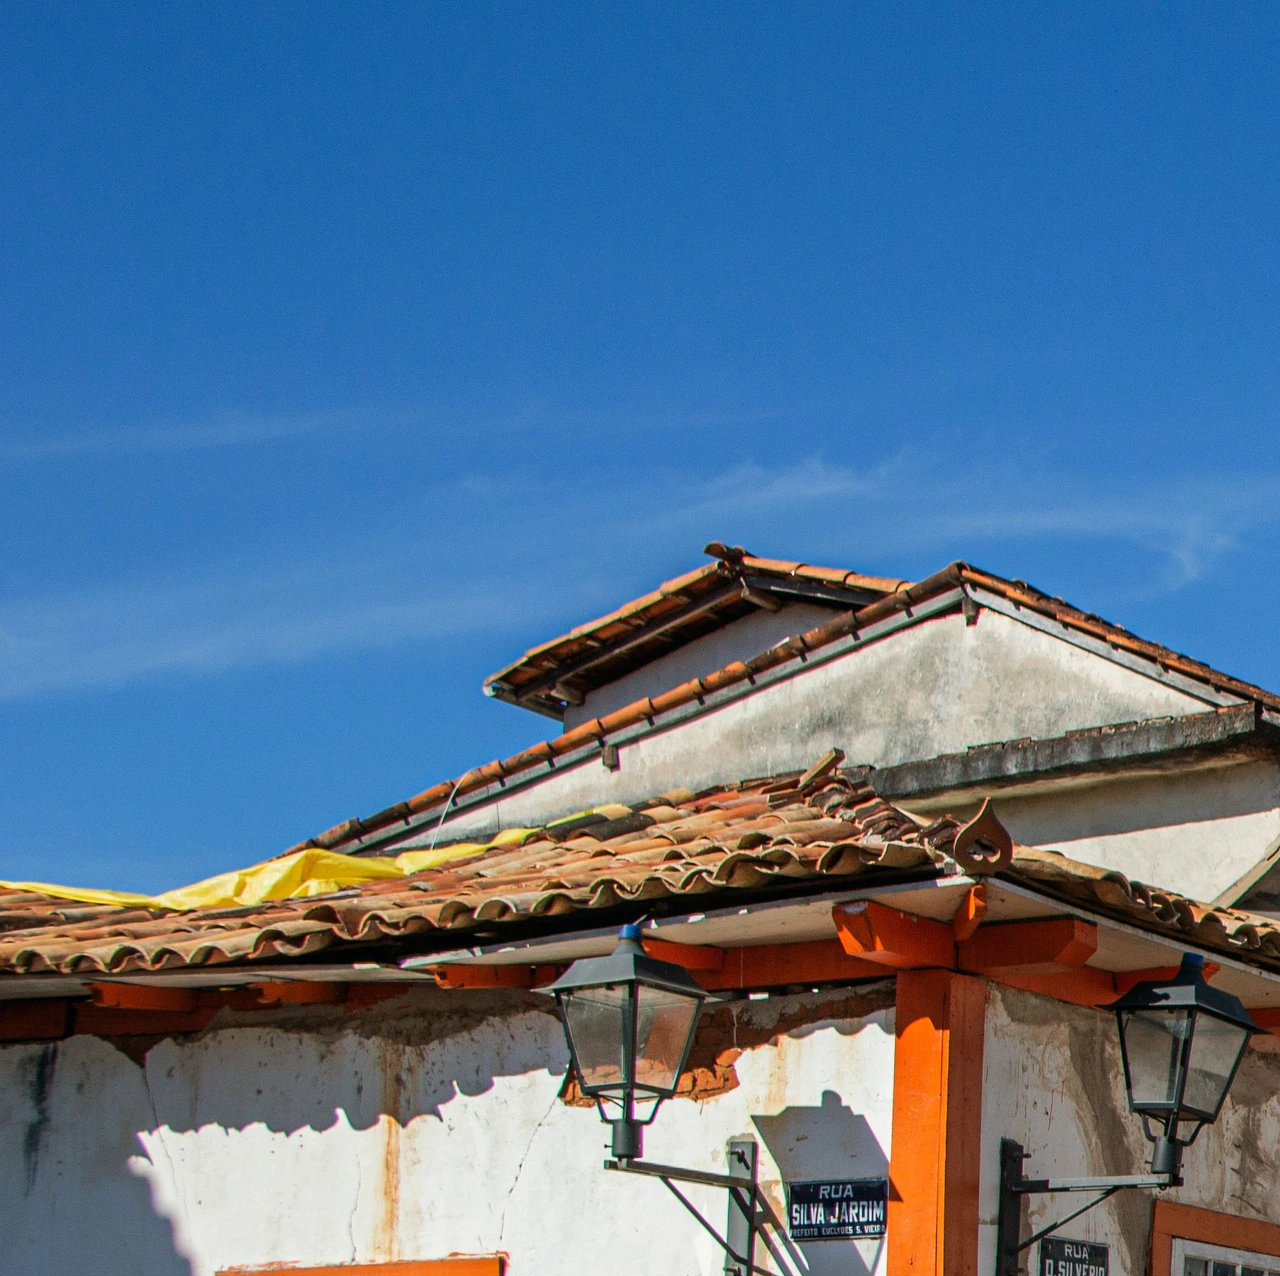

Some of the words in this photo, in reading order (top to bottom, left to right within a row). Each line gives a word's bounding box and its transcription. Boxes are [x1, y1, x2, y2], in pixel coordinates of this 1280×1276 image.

[819, 1184, 854, 1199] RUA
[792, 1202, 825, 1226] SILVA
[830, 1200, 884, 1224] JARDIM
[790, 1227, 819, 1237] PREFEITO
[856, 1225, 862, 1234] S.
[1064, 1244, 1089, 1260] RUA
